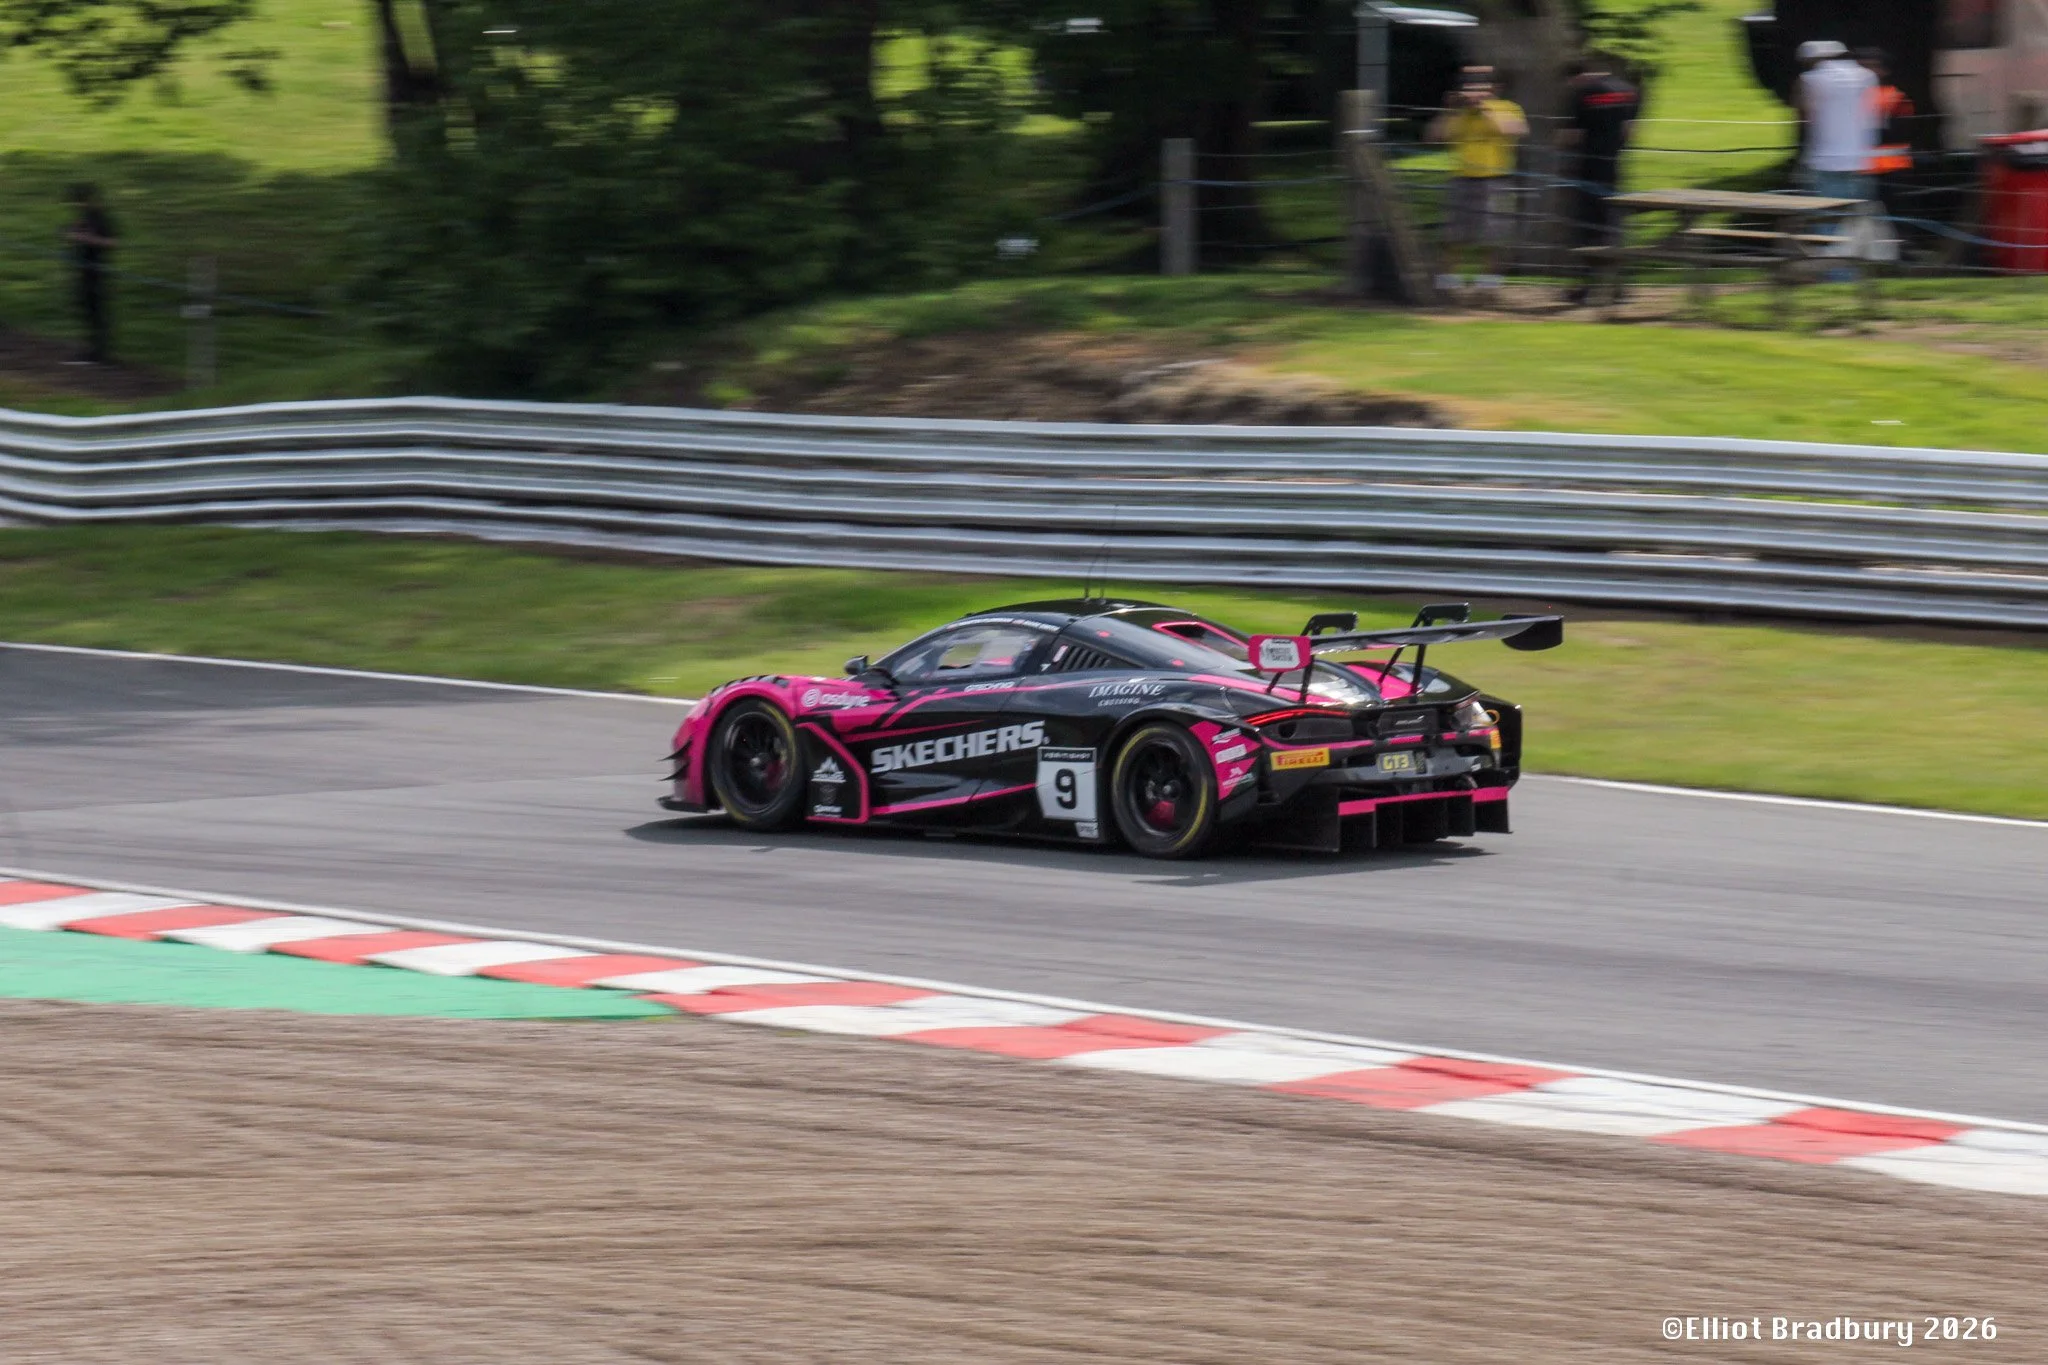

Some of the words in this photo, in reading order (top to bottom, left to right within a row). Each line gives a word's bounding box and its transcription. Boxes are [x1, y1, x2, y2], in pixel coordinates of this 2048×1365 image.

[1088, 684, 1166, 698] IMAGINE
[871, 720, 1046, 774] SKECHERS
[1276, 751, 1325, 767] PIRELLI
[1383, 754, 1409, 770] GT3
[1055, 768, 1077, 810] 9
